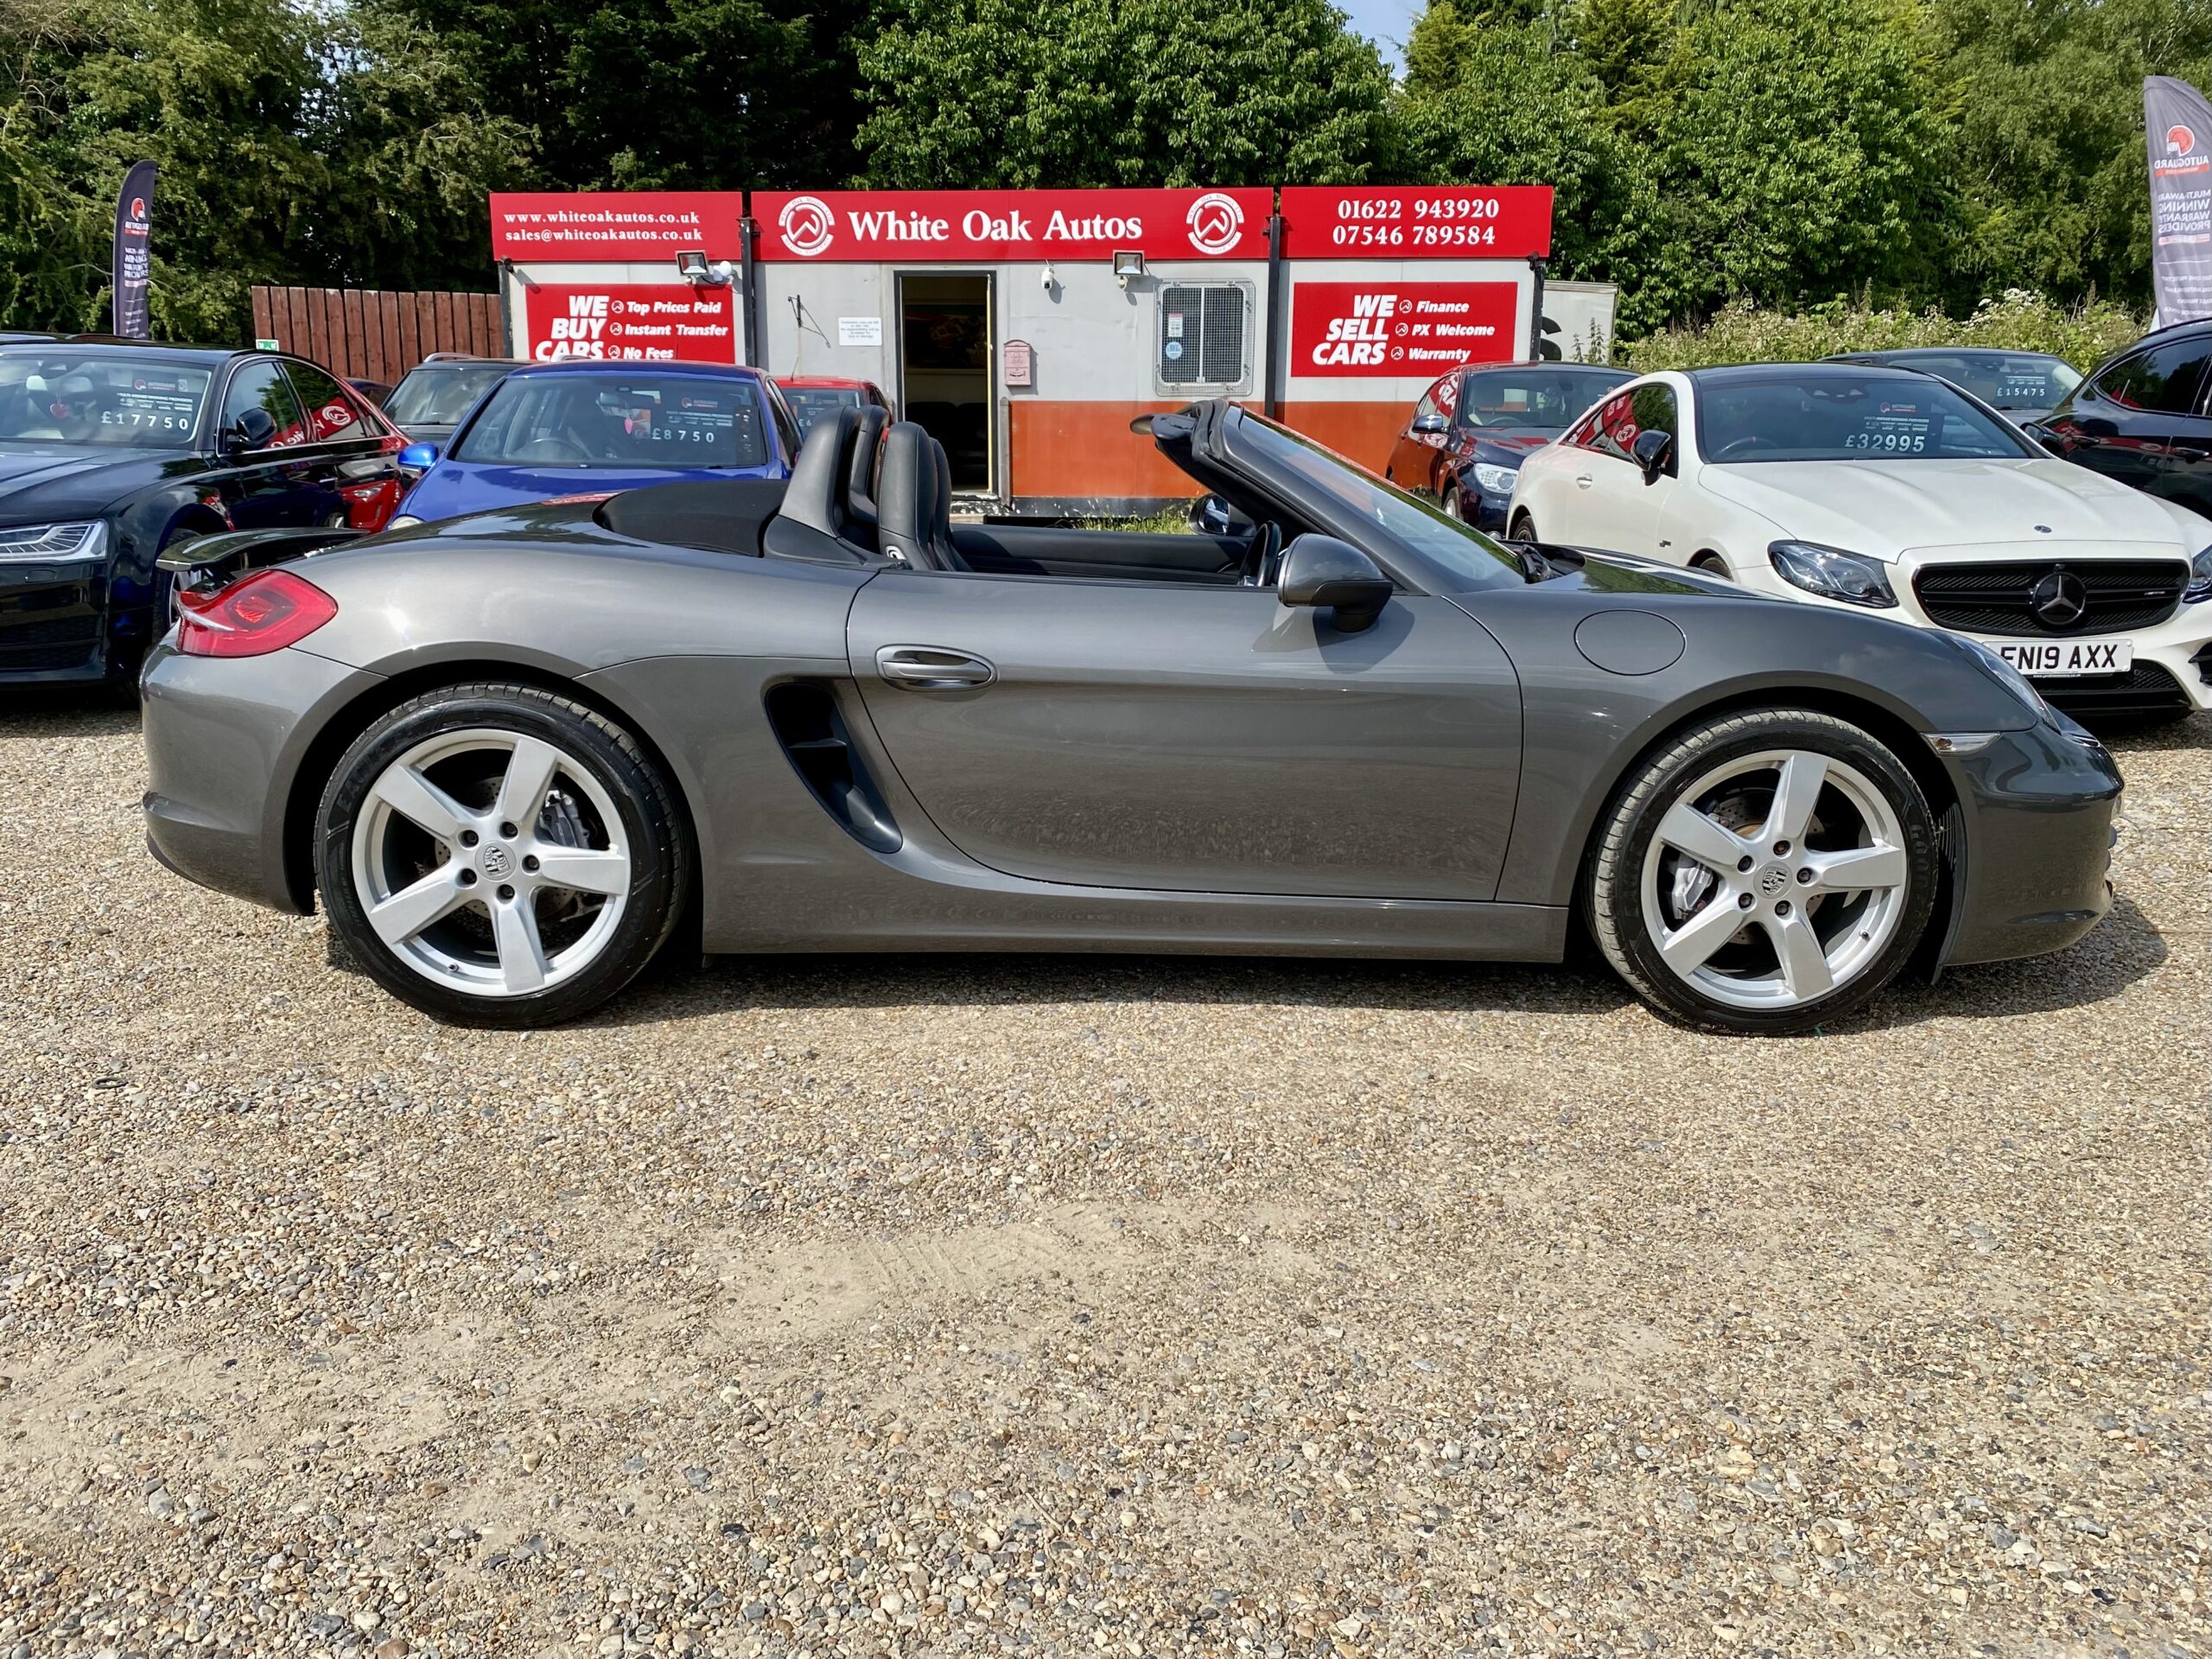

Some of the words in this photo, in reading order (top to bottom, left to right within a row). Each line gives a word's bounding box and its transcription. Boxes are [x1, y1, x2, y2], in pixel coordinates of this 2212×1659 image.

[504, 210, 700, 224] www.whiteoakautos.co.uk
[1338, 199, 1402, 219] 01622
[1414, 199, 1500, 219] 943920
[505, 228, 702, 242] sales@whiteoakautos.co.uk
[847, 210, 949, 241] White
[962, 210, 1033, 241] Oak
[1042, 210, 1142, 241] Autos
[1332, 225, 1404, 245] 07546
[1413, 225, 1496, 245] 789584
[569, 296, 610, 317] WE
[626, 302, 651, 316] Top
[653, 302, 690, 314] Prices
[693, 302, 722, 314] Paid
[1353, 295, 1397, 317] WE
[1416, 300, 1470, 314] Finance
[550, 318, 607, 340] BUY
[625, 324, 671, 336] Instant
[676, 324, 728, 336] Transfer
[1325, 318, 1389, 341] SELL
[1412, 324, 1431, 336] PX
[1435, 324, 1496, 336] Welcome
[535, 340, 604, 362] CARS
[623, 347, 642, 359] No
[645, 347, 674, 359] Fees
[1312, 342, 1388, 365] CARS
[1408, 347, 1471, 363] Warranty
[1997, 387, 2045, 397] £15475
[101, 410, 188, 430] £17750
[652, 428, 715, 443] £8750
[1845, 433, 1925, 453] £32995
[2000, 645, 2061, 670] EN19
[2068, 644, 2118, 669] AXX
